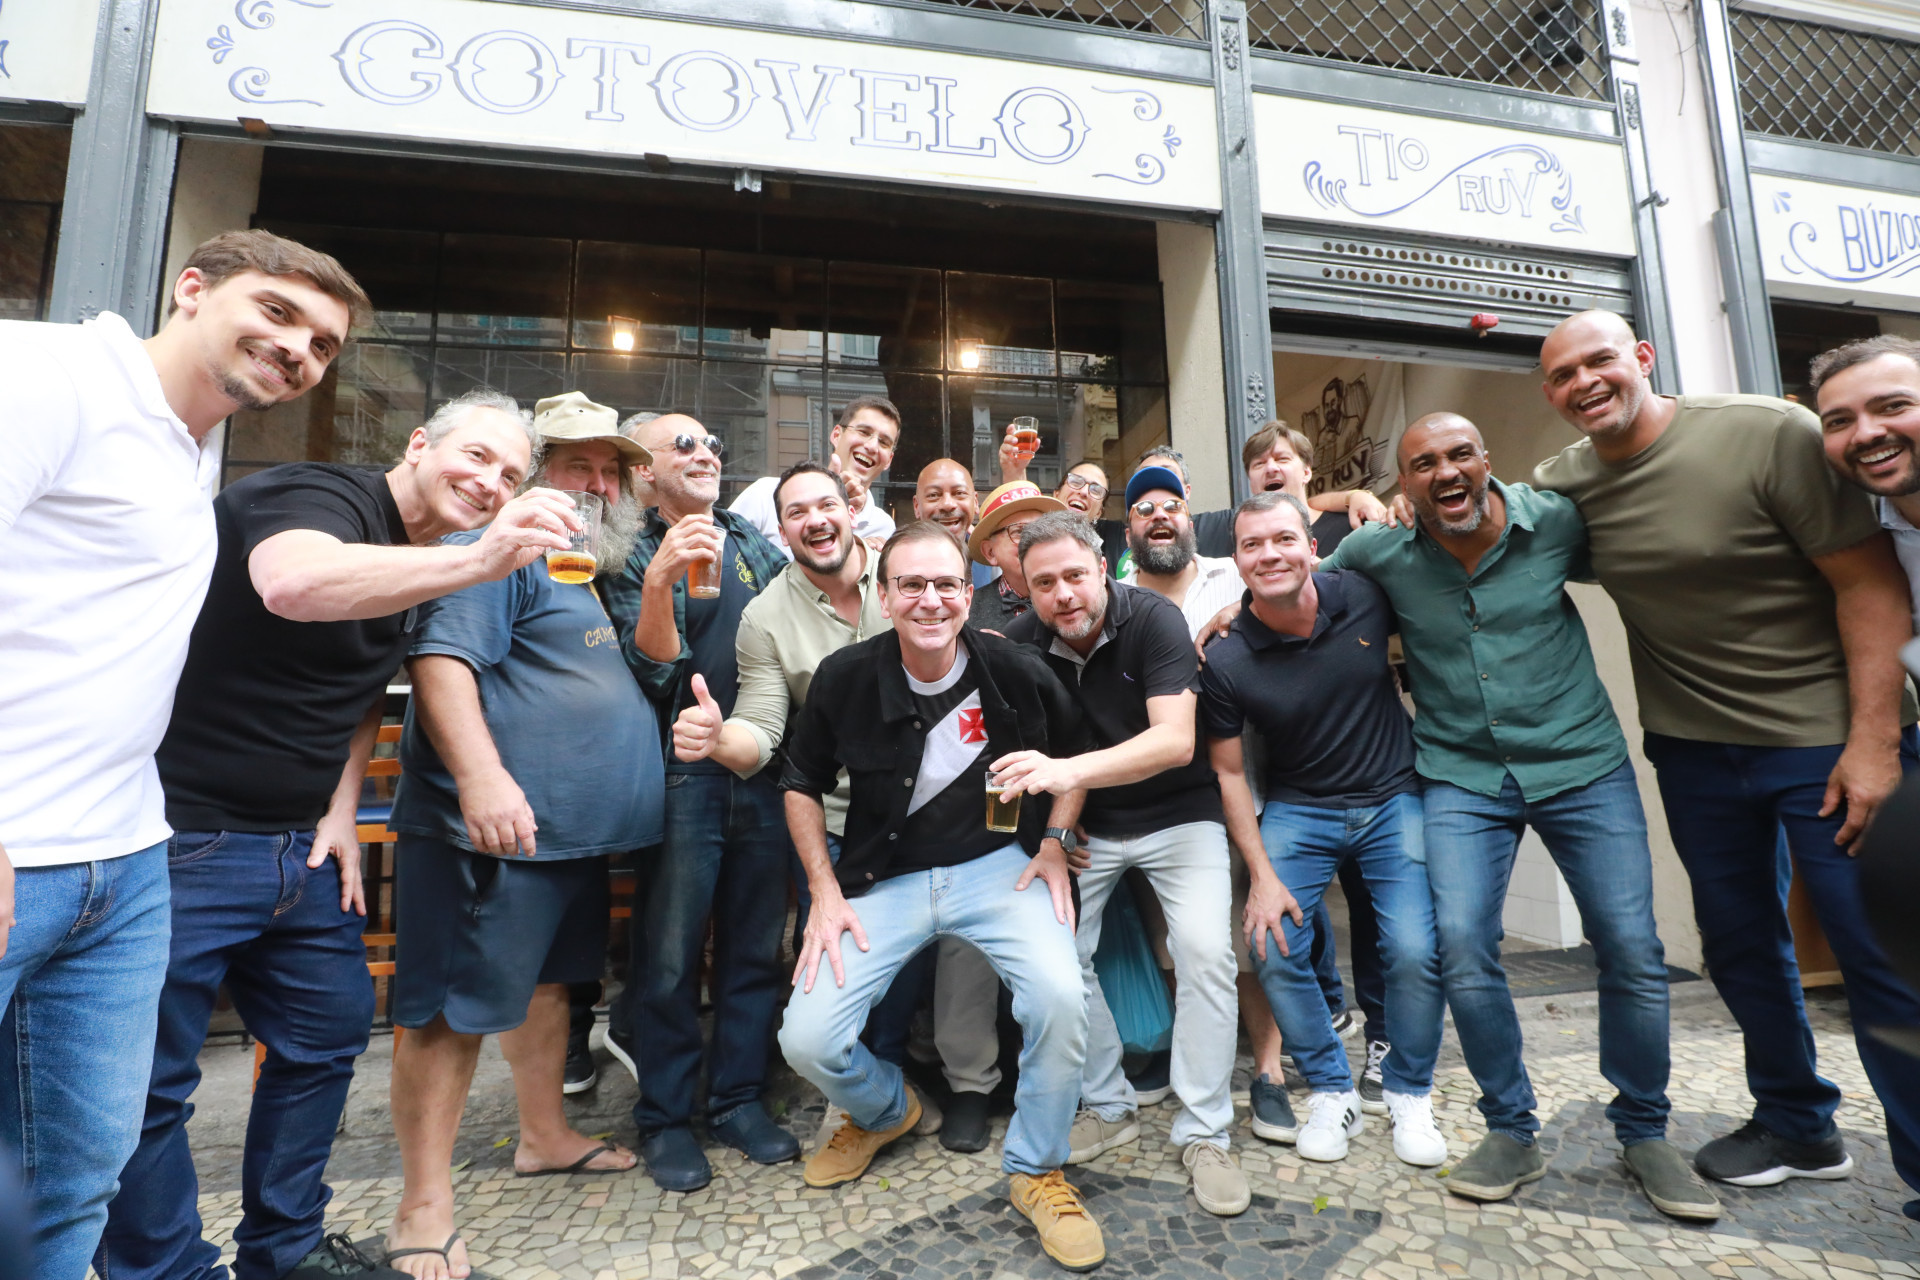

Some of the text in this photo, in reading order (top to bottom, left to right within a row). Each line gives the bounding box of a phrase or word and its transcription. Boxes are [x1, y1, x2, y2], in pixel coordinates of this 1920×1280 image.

[330, 20, 1091, 164] GOTOVELO
[1337, 125, 1429, 187] TIO
[1456, 168, 1539, 218] RUY
[1331, 449, 1368, 489] RUY
